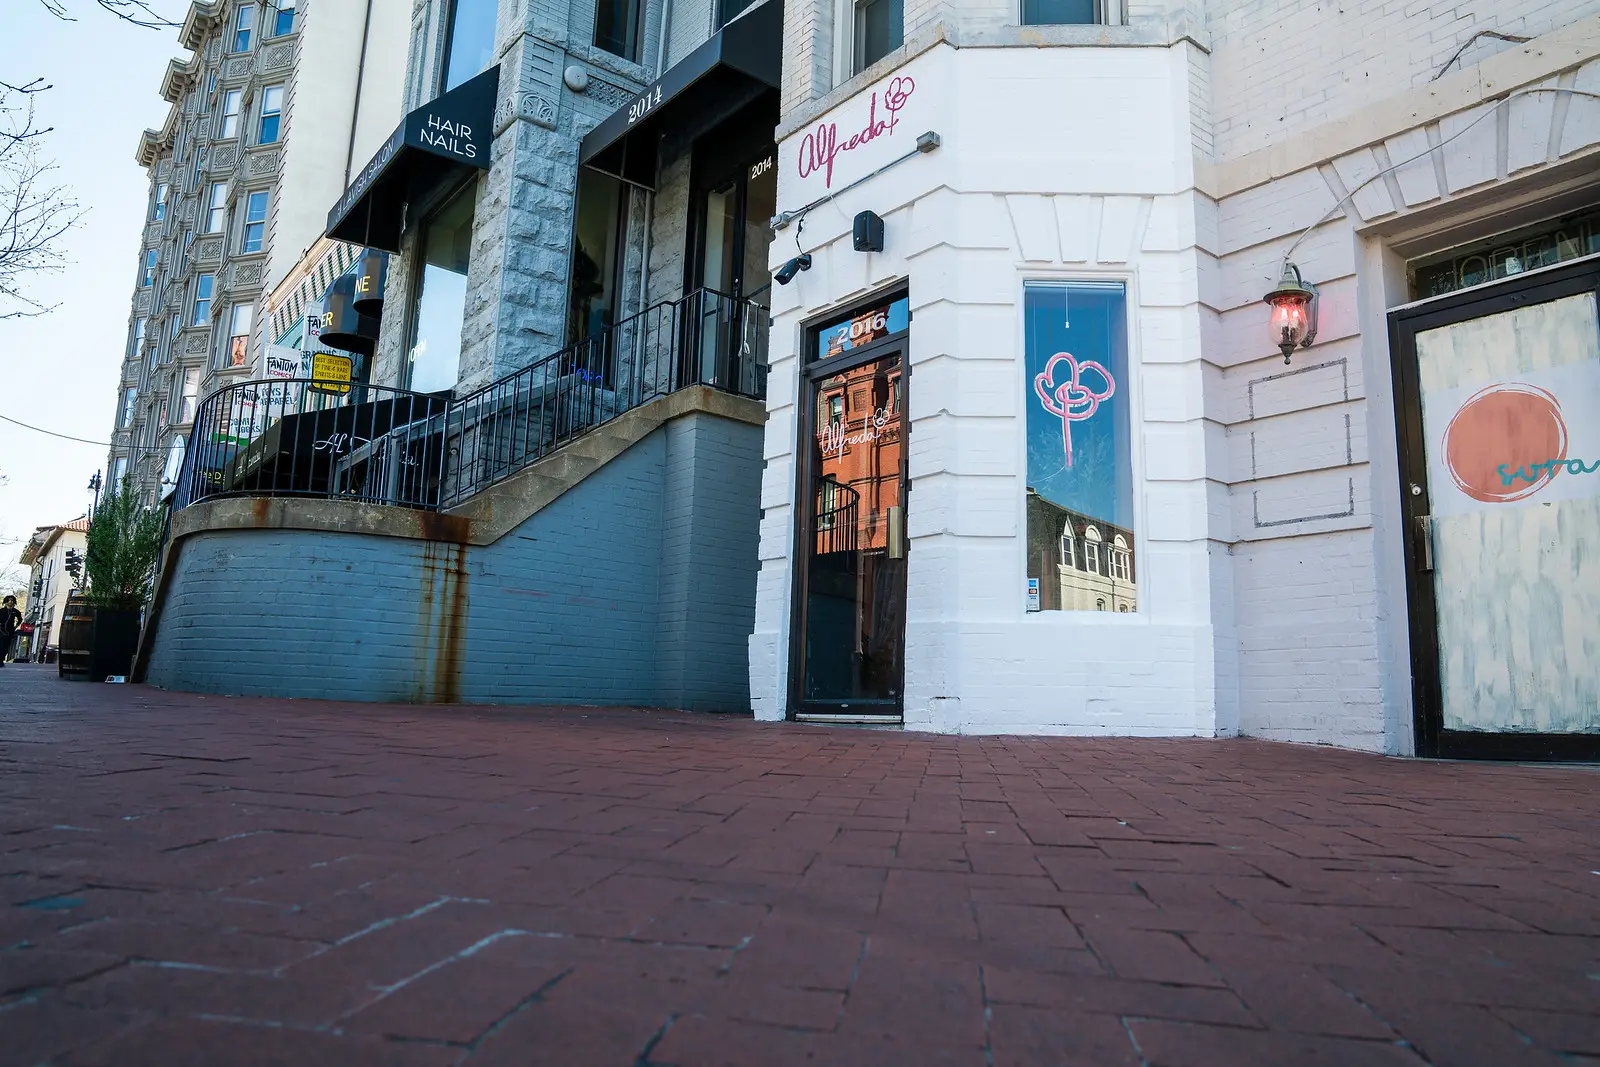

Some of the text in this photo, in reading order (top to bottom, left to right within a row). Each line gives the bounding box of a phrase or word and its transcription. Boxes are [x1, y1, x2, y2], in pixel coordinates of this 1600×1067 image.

[628, 84, 662, 125] 2014
[428, 114, 472, 140] HAIR
[420, 129, 476, 158] NAILS
[368, 138, 395, 179] SALON
[751, 156, 772, 179] 2014
[837, 312, 886, 345] 2016
[267, 357, 298, 379] FANTOM
[270, 370, 292, 379] COMICS
